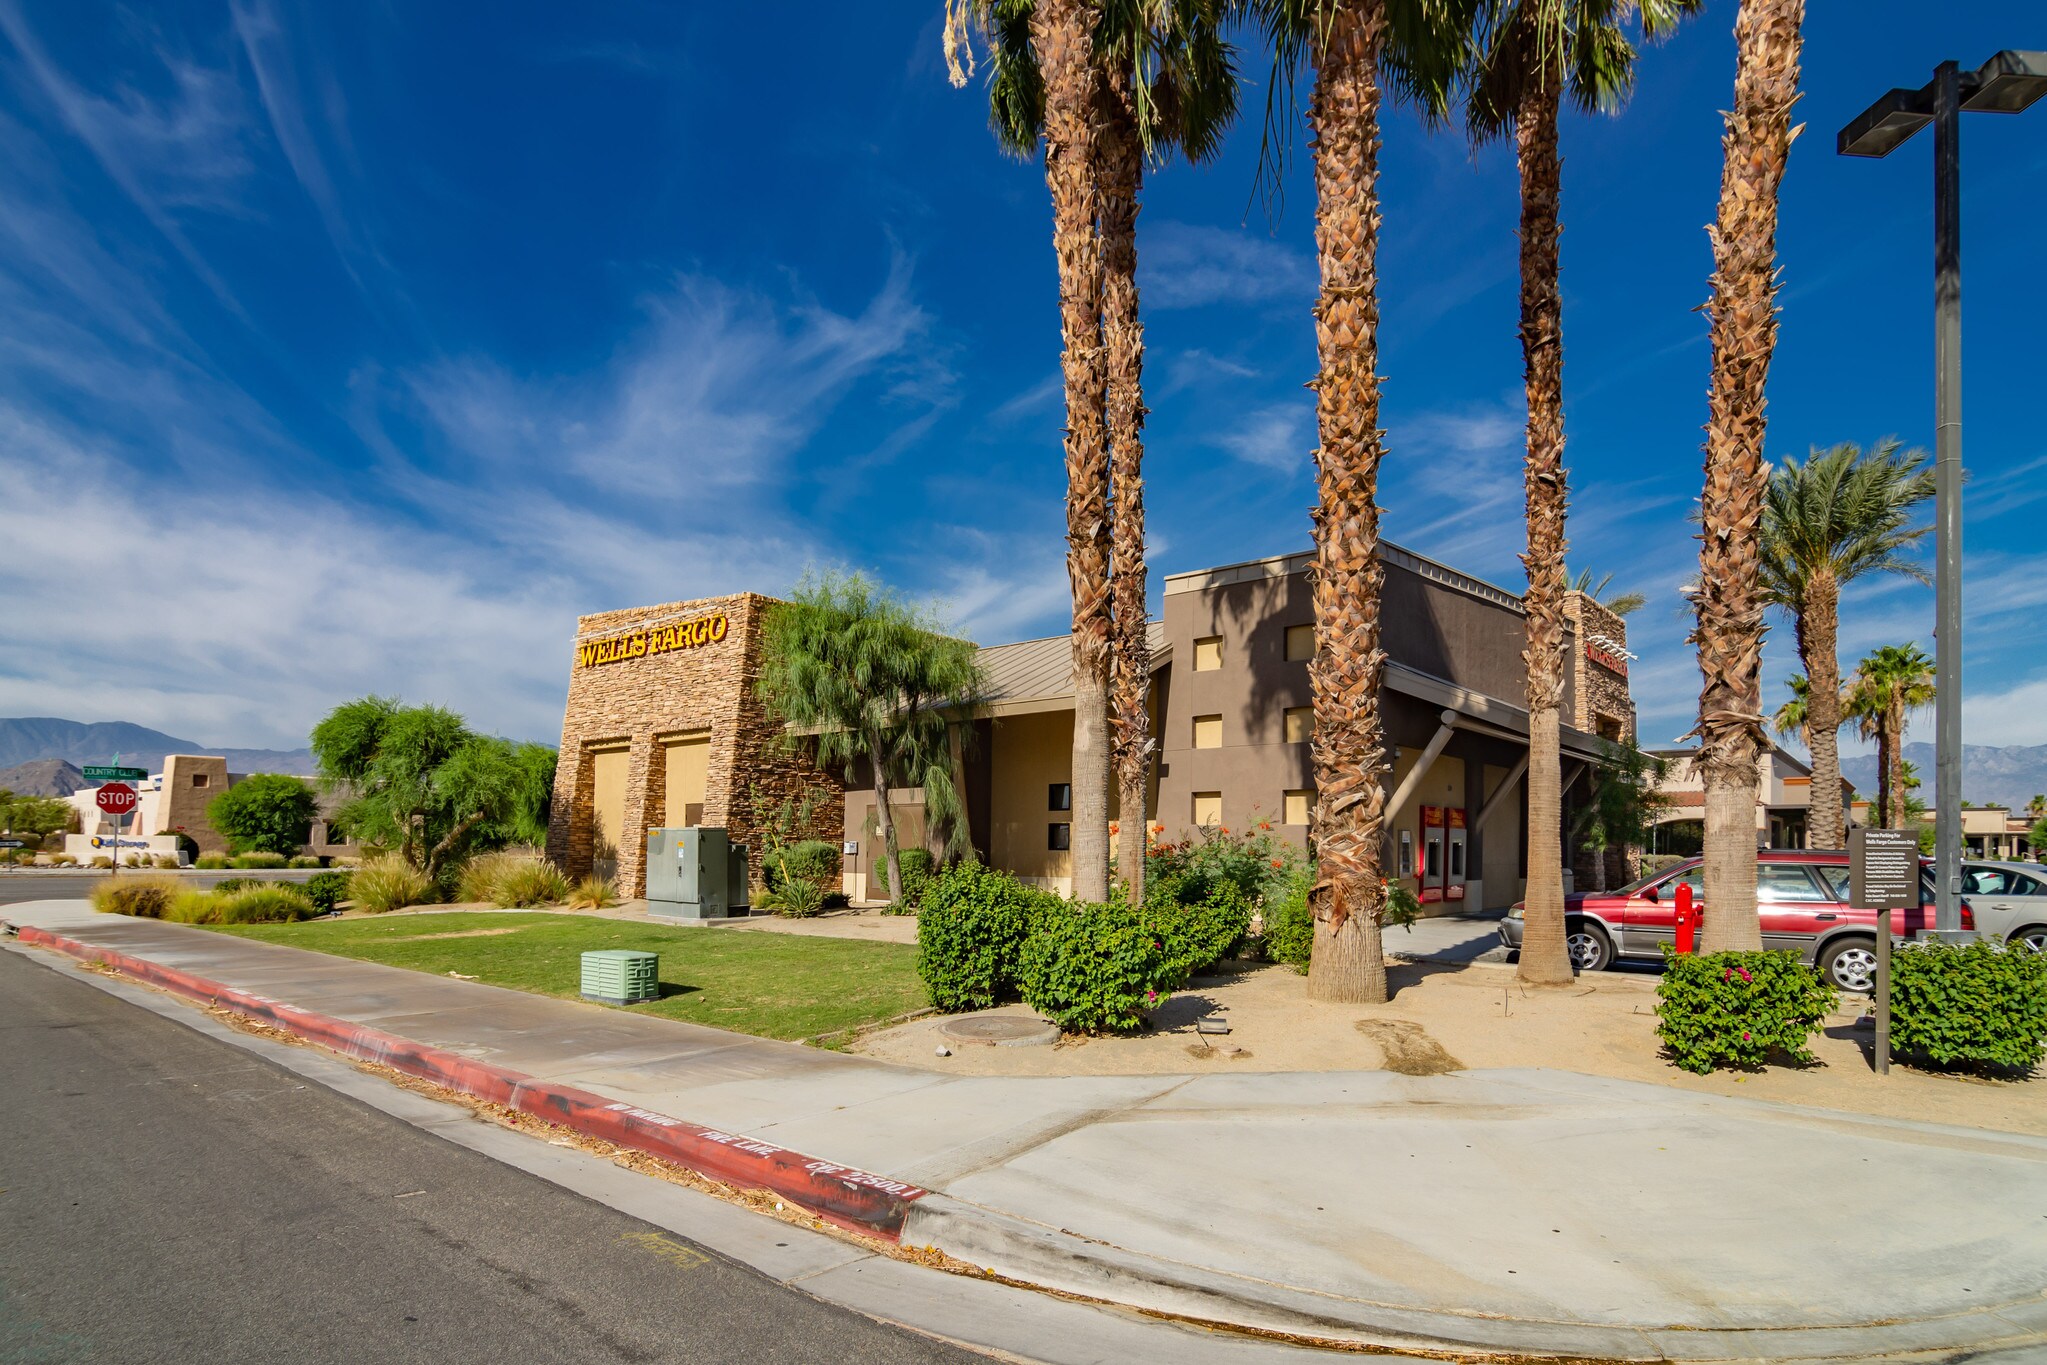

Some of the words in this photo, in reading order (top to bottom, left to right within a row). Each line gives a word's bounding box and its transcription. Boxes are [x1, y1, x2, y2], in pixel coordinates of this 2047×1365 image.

[580, 630, 648, 668] WELLS
[649, 613, 729, 654] FARGO
[83, 767, 117, 776] COUNTRY
[118, 769, 138, 777] CLUB
[98, 792, 135, 805] STOP
[697, 1131, 740, 1144] FIRE
